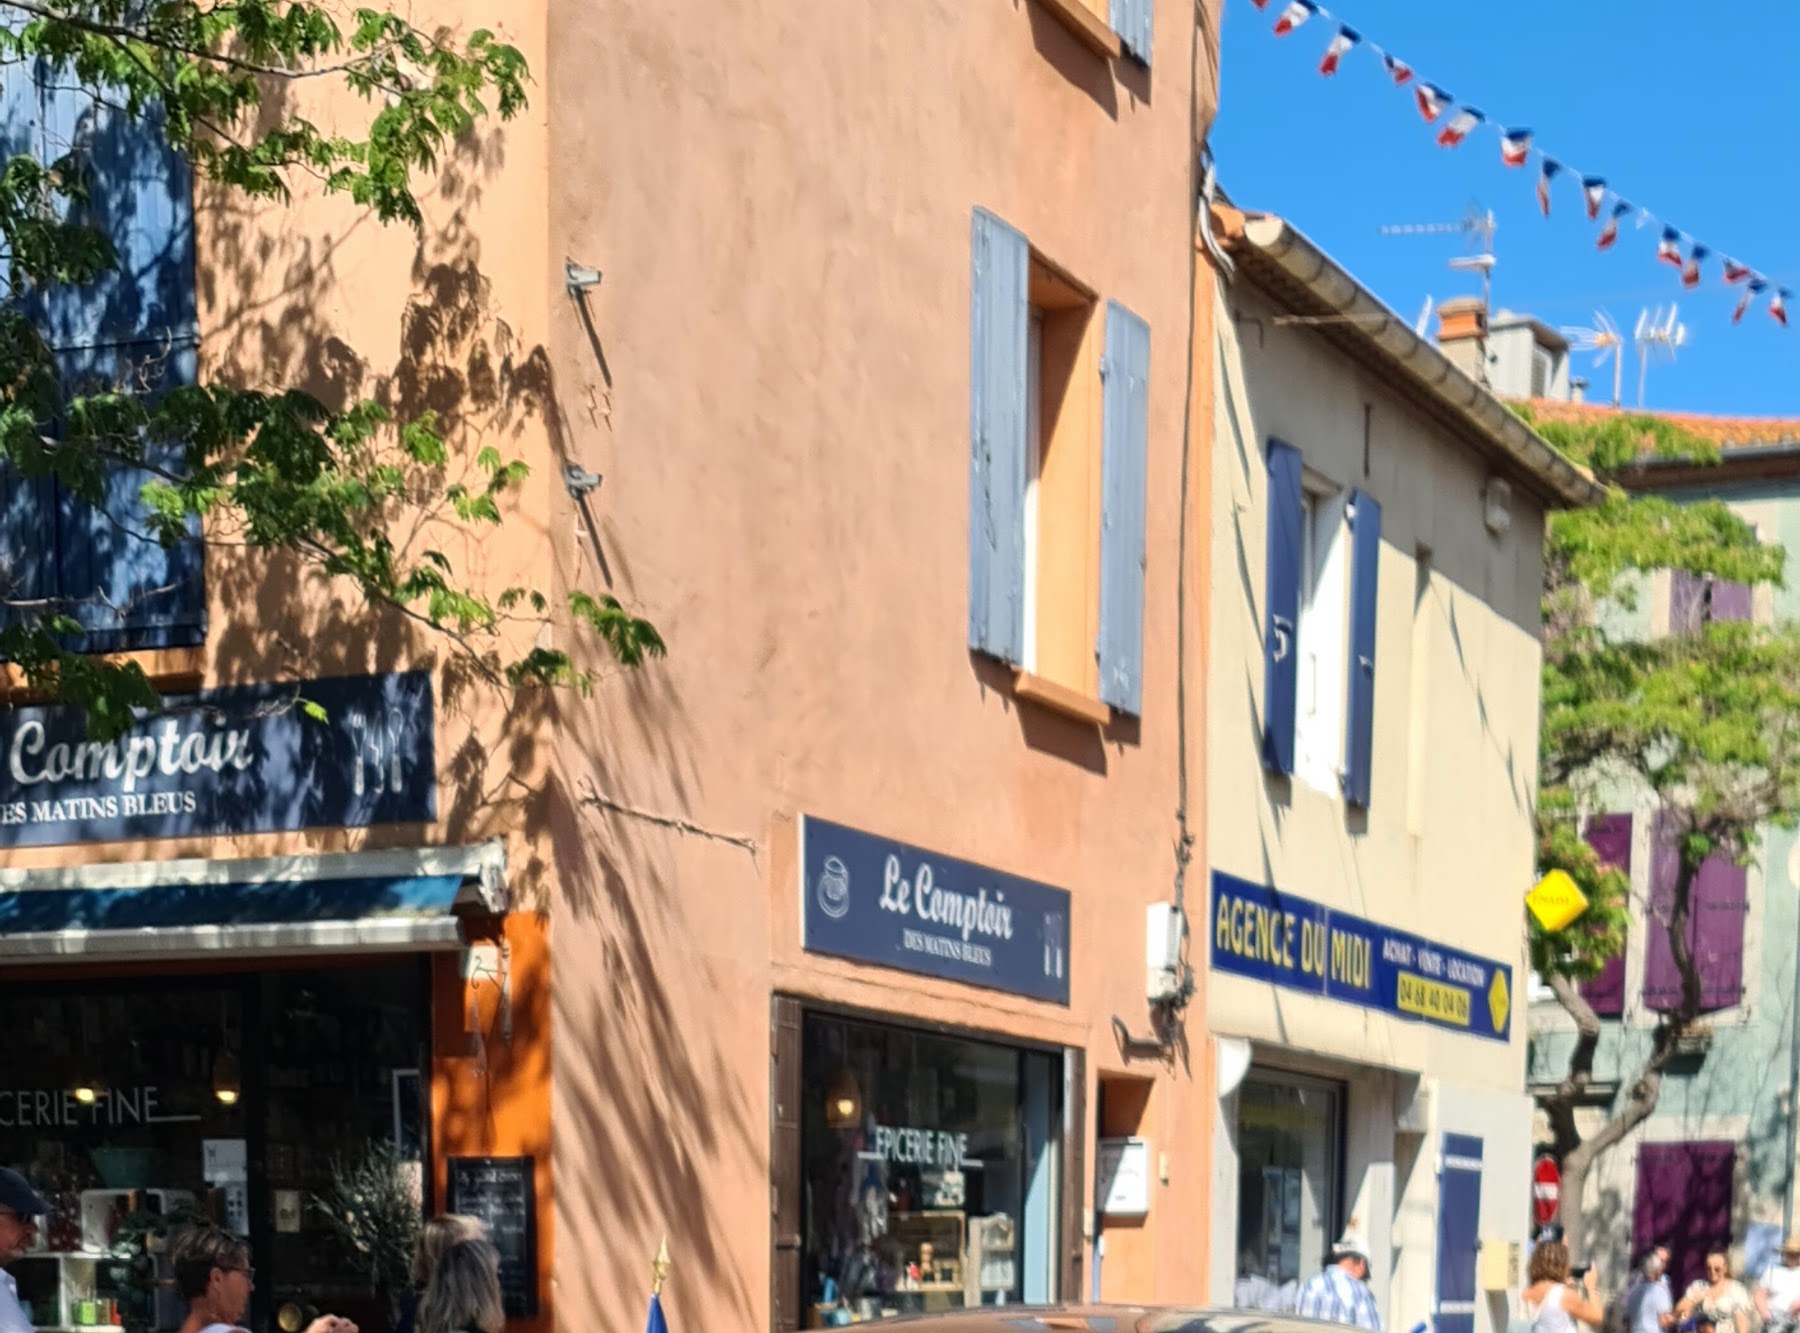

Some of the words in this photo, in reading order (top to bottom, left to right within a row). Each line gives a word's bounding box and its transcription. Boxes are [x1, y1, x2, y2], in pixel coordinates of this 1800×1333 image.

[9, 716, 254, 792] Comptoir
[32, 795, 118, 823] MATINS
[123, 791, 196, 817] BLEUS
[879, 853, 911, 914] Le
[914, 863, 1013, 942] Comptoir
[903, 928, 924, 951] DES
[924, 933, 961, 960] MATINS
[962, 942, 992, 967] BLEUS
[1216, 893, 1296, 969] AGENCE
[1301, 917, 1326, 977] DU
[1331, 928, 1372, 990] MIDI
[1382, 937, 1411, 966] ACHAT
[1446, 956, 1485, 988] LOCATION
[91, 1086, 159, 1124] FINE
[875, 1125, 934, 1163] EPICERIE
[937, 1130, 968, 1166] FINE
